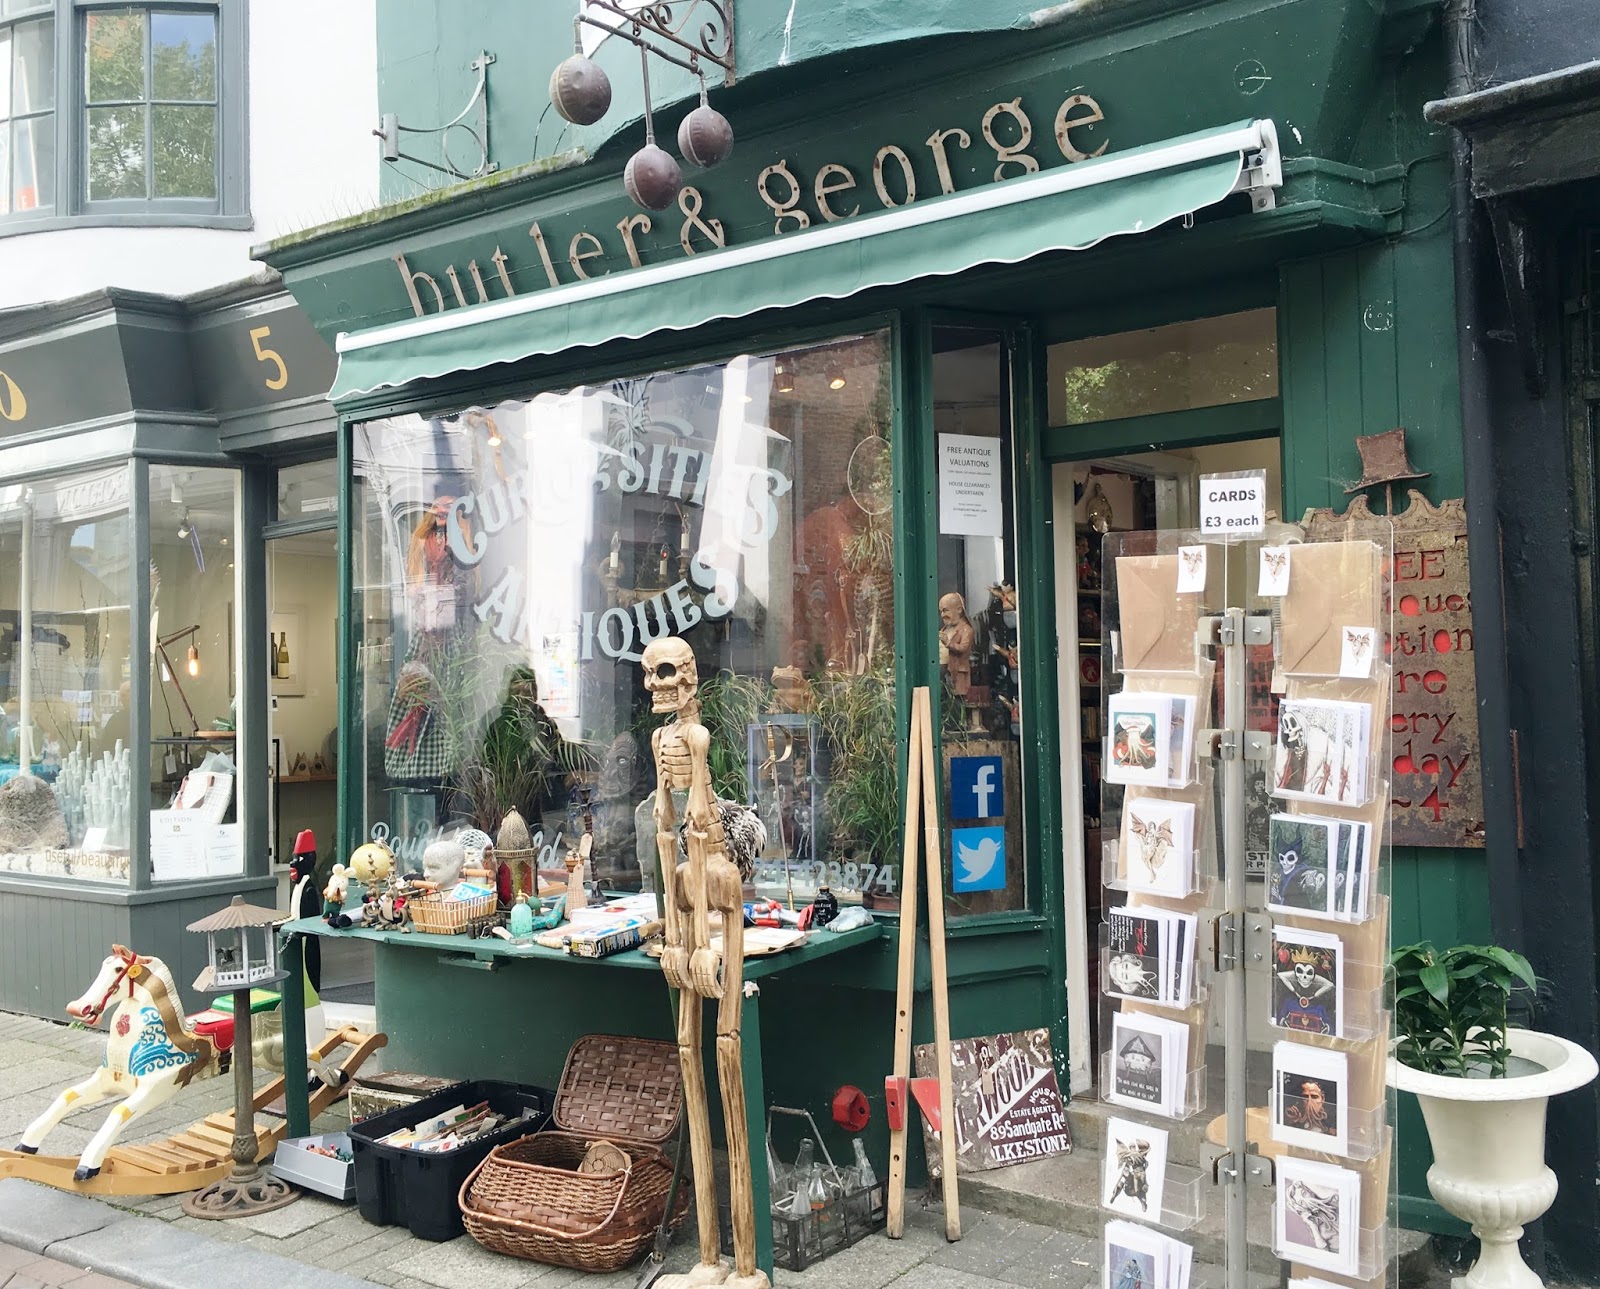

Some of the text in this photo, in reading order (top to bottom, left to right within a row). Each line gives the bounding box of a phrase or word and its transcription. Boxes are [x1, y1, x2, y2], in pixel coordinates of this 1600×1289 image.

[391, 94, 1110, 317] butler & george
[249, 326, 288, 390] 5
[947, 446, 991, 456] FREE ANTIQUE
[950, 458, 989, 468] VALUATIONS
[1208, 490, 1256, 502] CARDS
[1205, 515, 1259, 527] £3 each
[474, 542, 739, 663] AIQUES
[1395, 669, 1448, 694] re
[1386, 711, 1457, 744] ery
[1393, 739, 1471, 788] day
[795, 858, 897, 894] 423874
[1029, 1087, 1057, 1104] HOUSE
[990, 1133, 1071, 1162] LKESTONE
